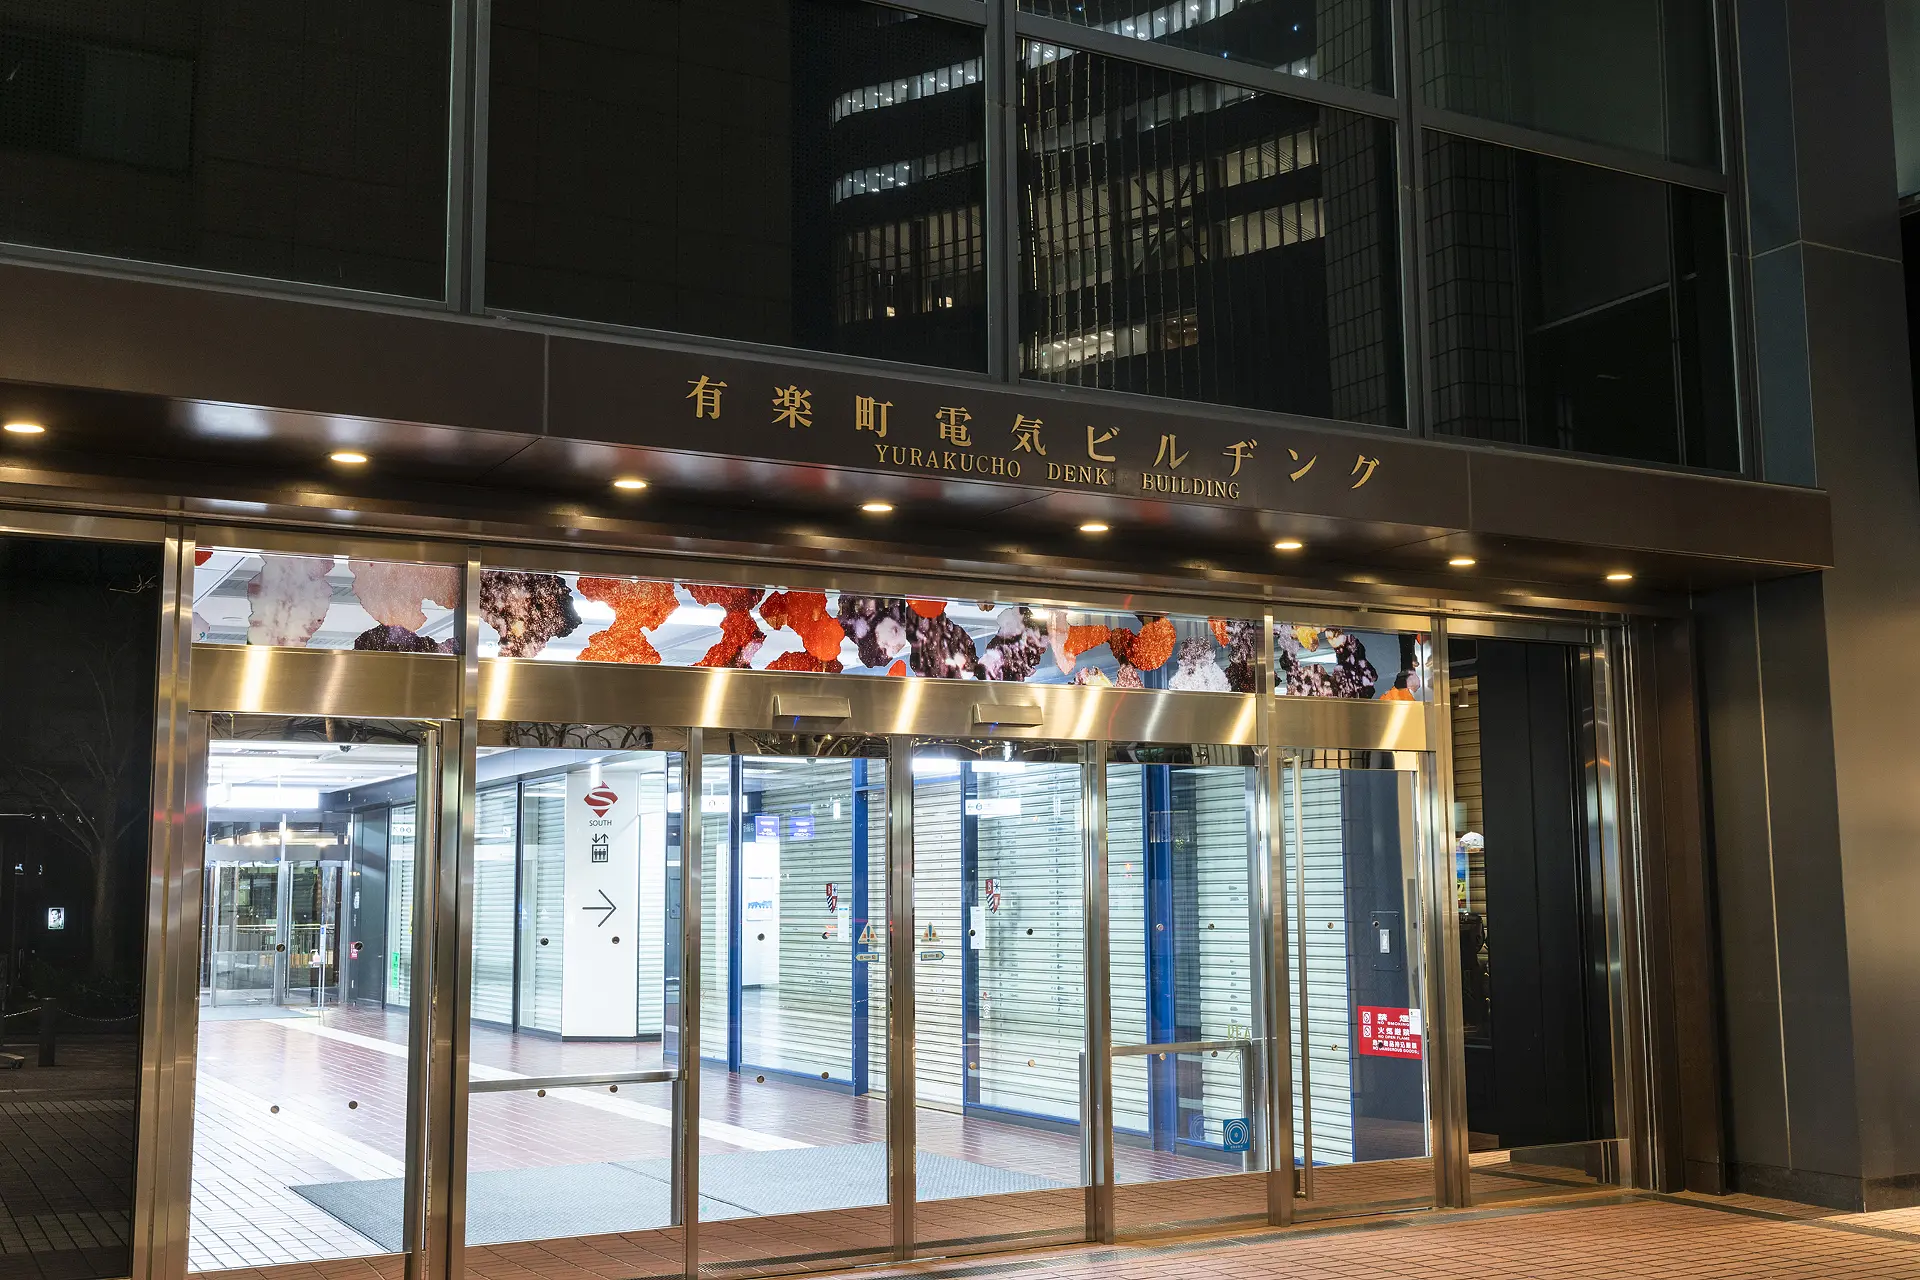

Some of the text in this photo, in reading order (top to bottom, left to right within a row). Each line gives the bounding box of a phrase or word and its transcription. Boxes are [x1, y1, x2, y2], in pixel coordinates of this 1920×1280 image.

[685, 373, 1381, 490] 有楽町電気ビルヂング
[875, 444, 1021, 478] YURAKUCHO
[1142, 472, 1240, 499] BUILDING
[589, 819, 612, 827] SOUTH
